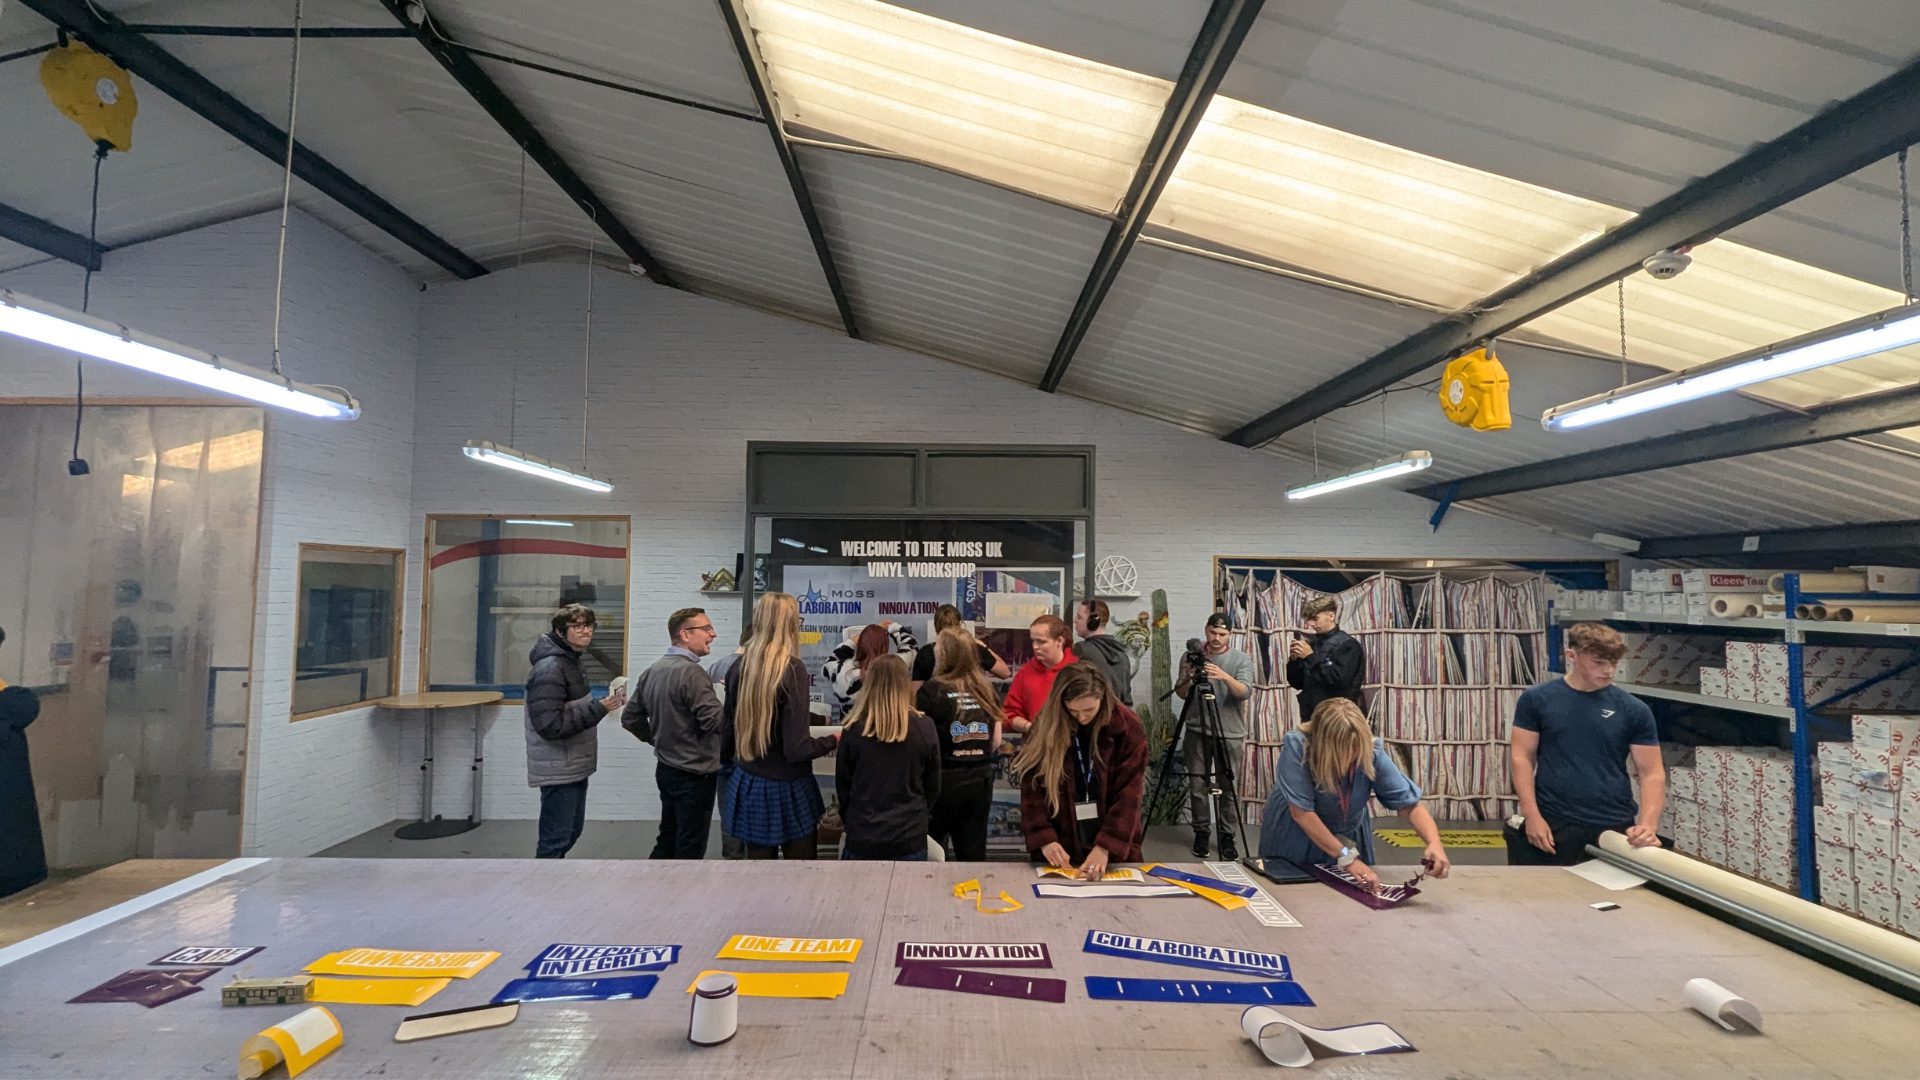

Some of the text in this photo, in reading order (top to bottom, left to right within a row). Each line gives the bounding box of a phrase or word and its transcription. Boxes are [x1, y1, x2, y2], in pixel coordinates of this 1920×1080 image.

[841, 541, 1003, 557] WELCOME TO THE MOSS UK
[867, 562, 976, 577] VINYL WORKSHOP
[1712, 575, 1743, 585] Kleen
[831, 590, 875, 598] MOSS
[799, 601, 862, 614] LABORATION
[878, 601, 939, 614] INNOVATION
[740, 937, 853, 952] ONE TEAM
[905, 944, 1042, 959] INNOVATION
[1095, 932, 1280, 969] COLLABORATION
[341, 949, 486, 968] OWNERSHIP
[540, 949, 665, 975] INTEGRITY
